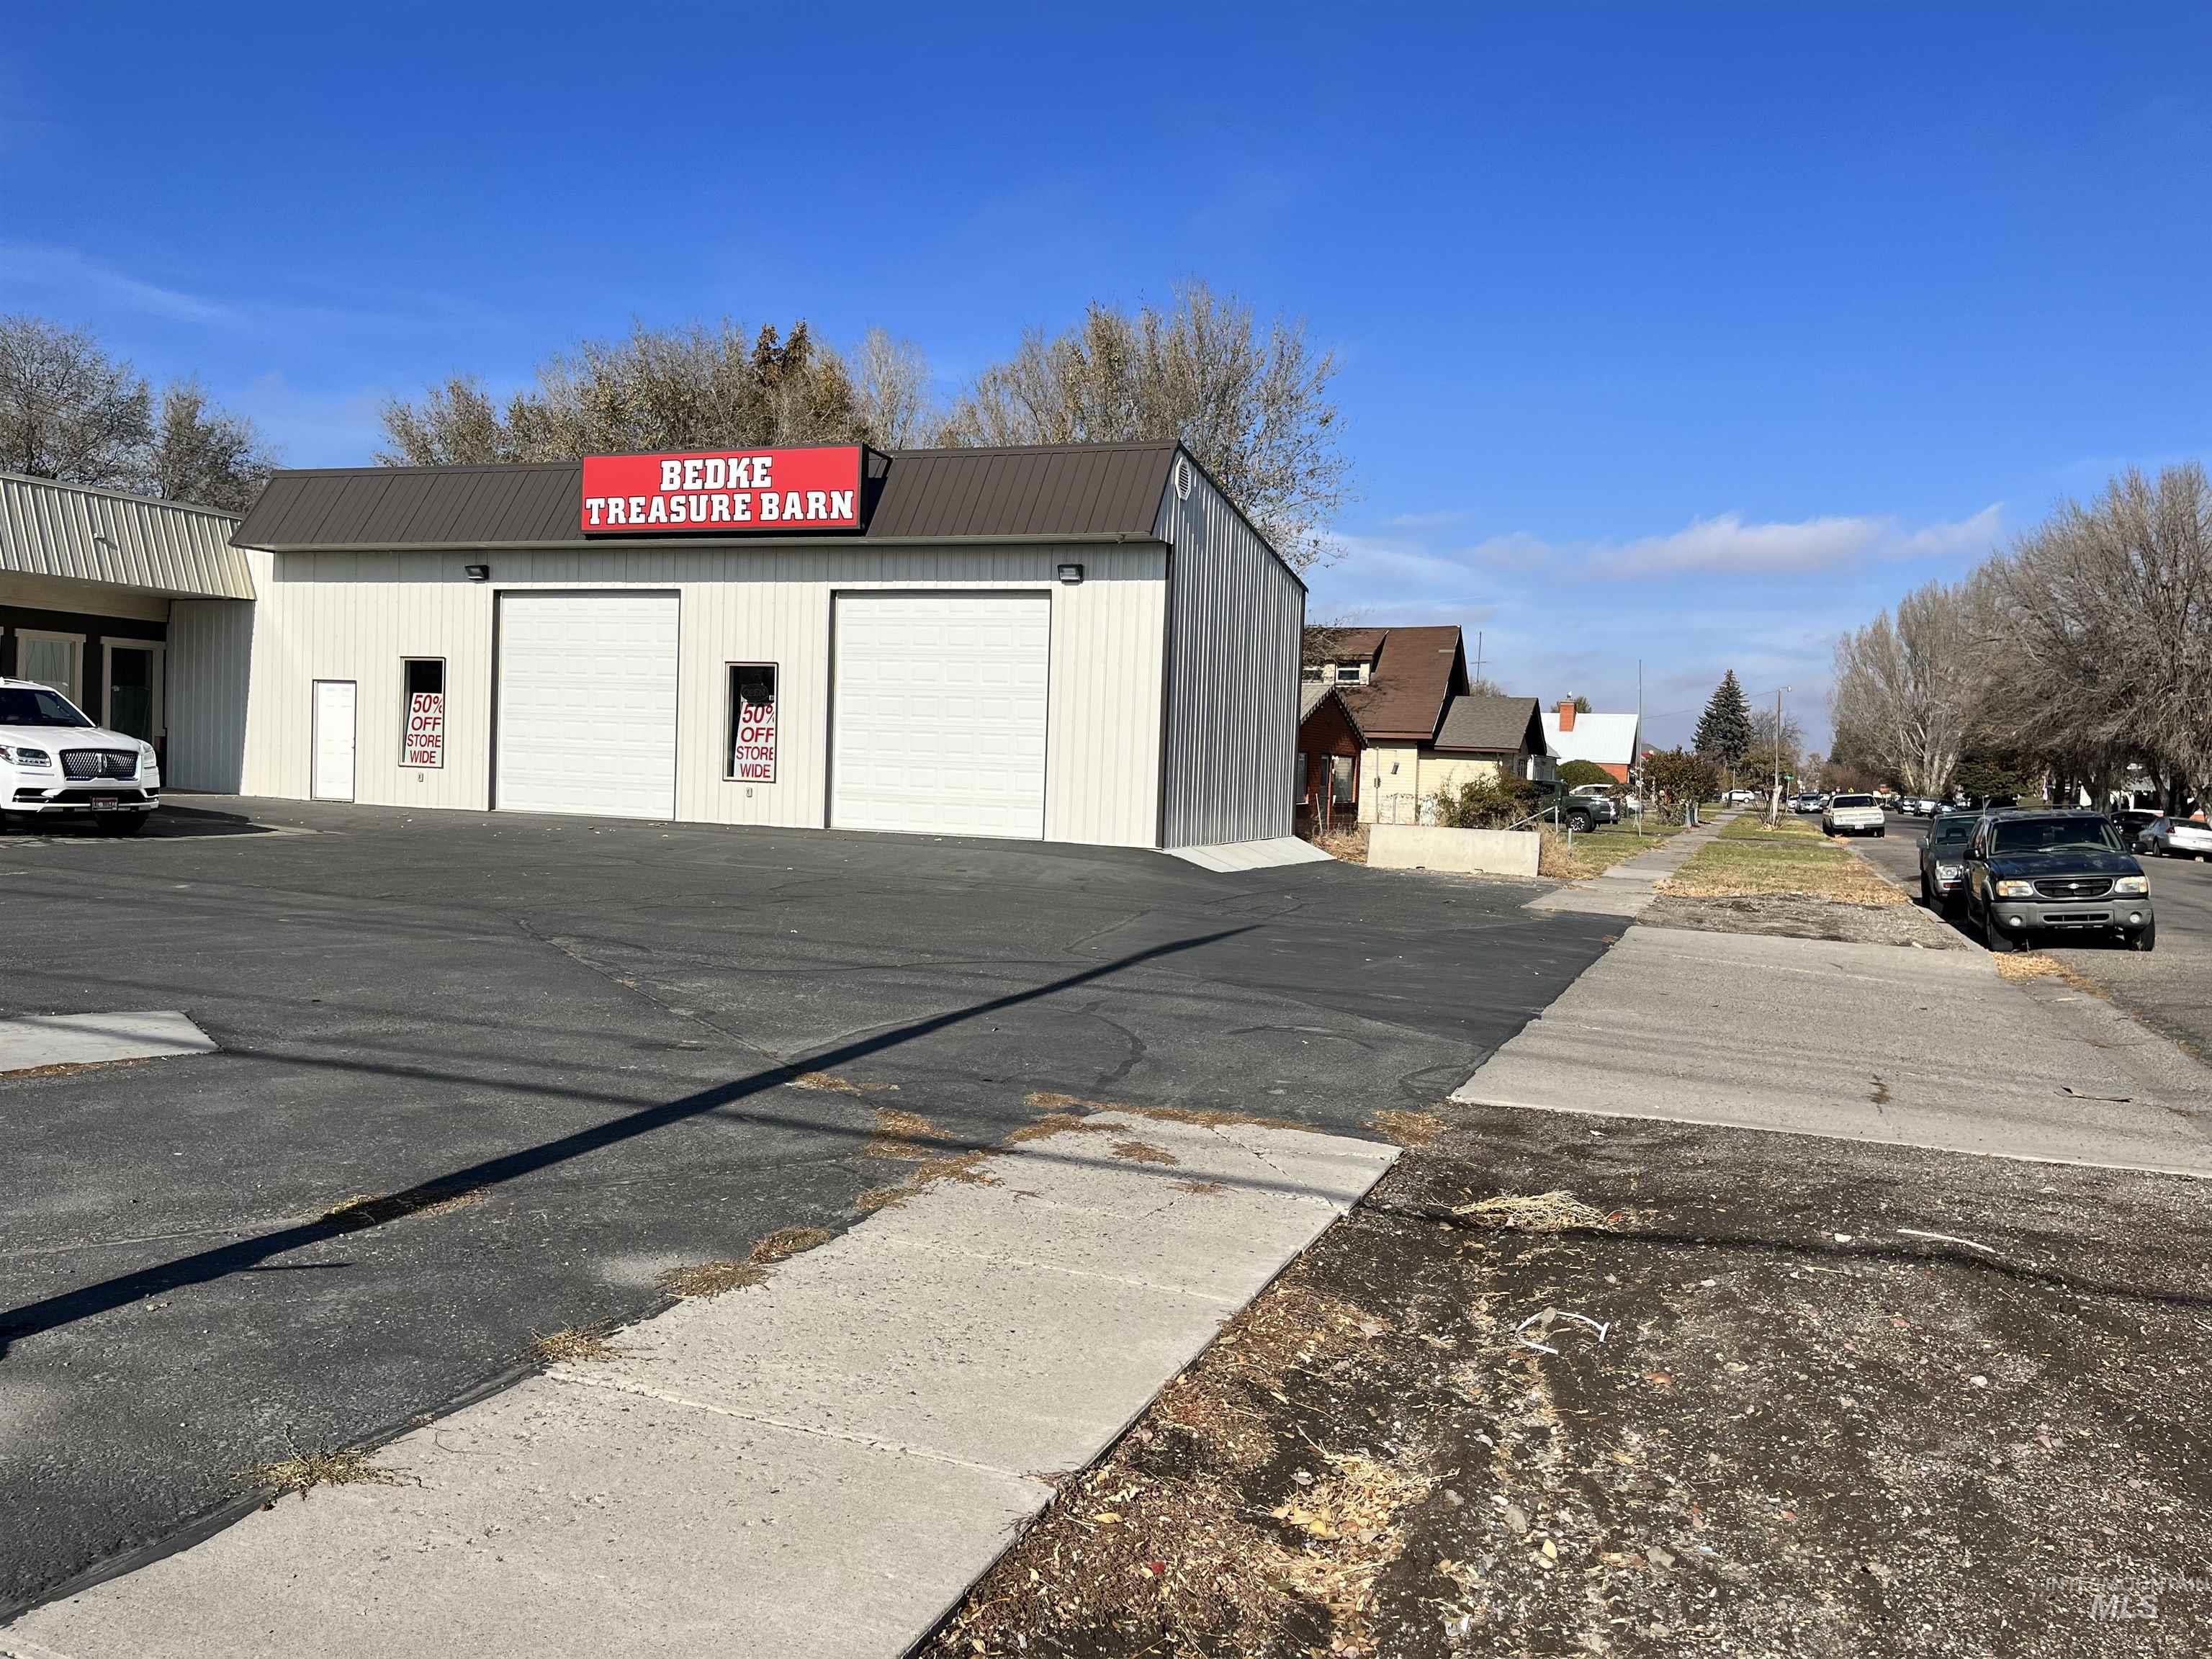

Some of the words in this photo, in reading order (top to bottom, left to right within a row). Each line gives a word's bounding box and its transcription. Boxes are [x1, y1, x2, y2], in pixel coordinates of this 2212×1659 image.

[660, 456, 773, 492] BEDKE
[585, 492, 752, 526] TREASURE
[760, 490, 854, 521] BARN
[413, 694, 442, 714] 50%
[411, 716, 441, 731] OFF
[407, 734, 441, 747] STORE
[740, 727, 774, 743] OFF
[410, 750, 436, 763] WIDE
[736, 746, 773, 761] STORE
[740, 763, 770, 778] WIDE
